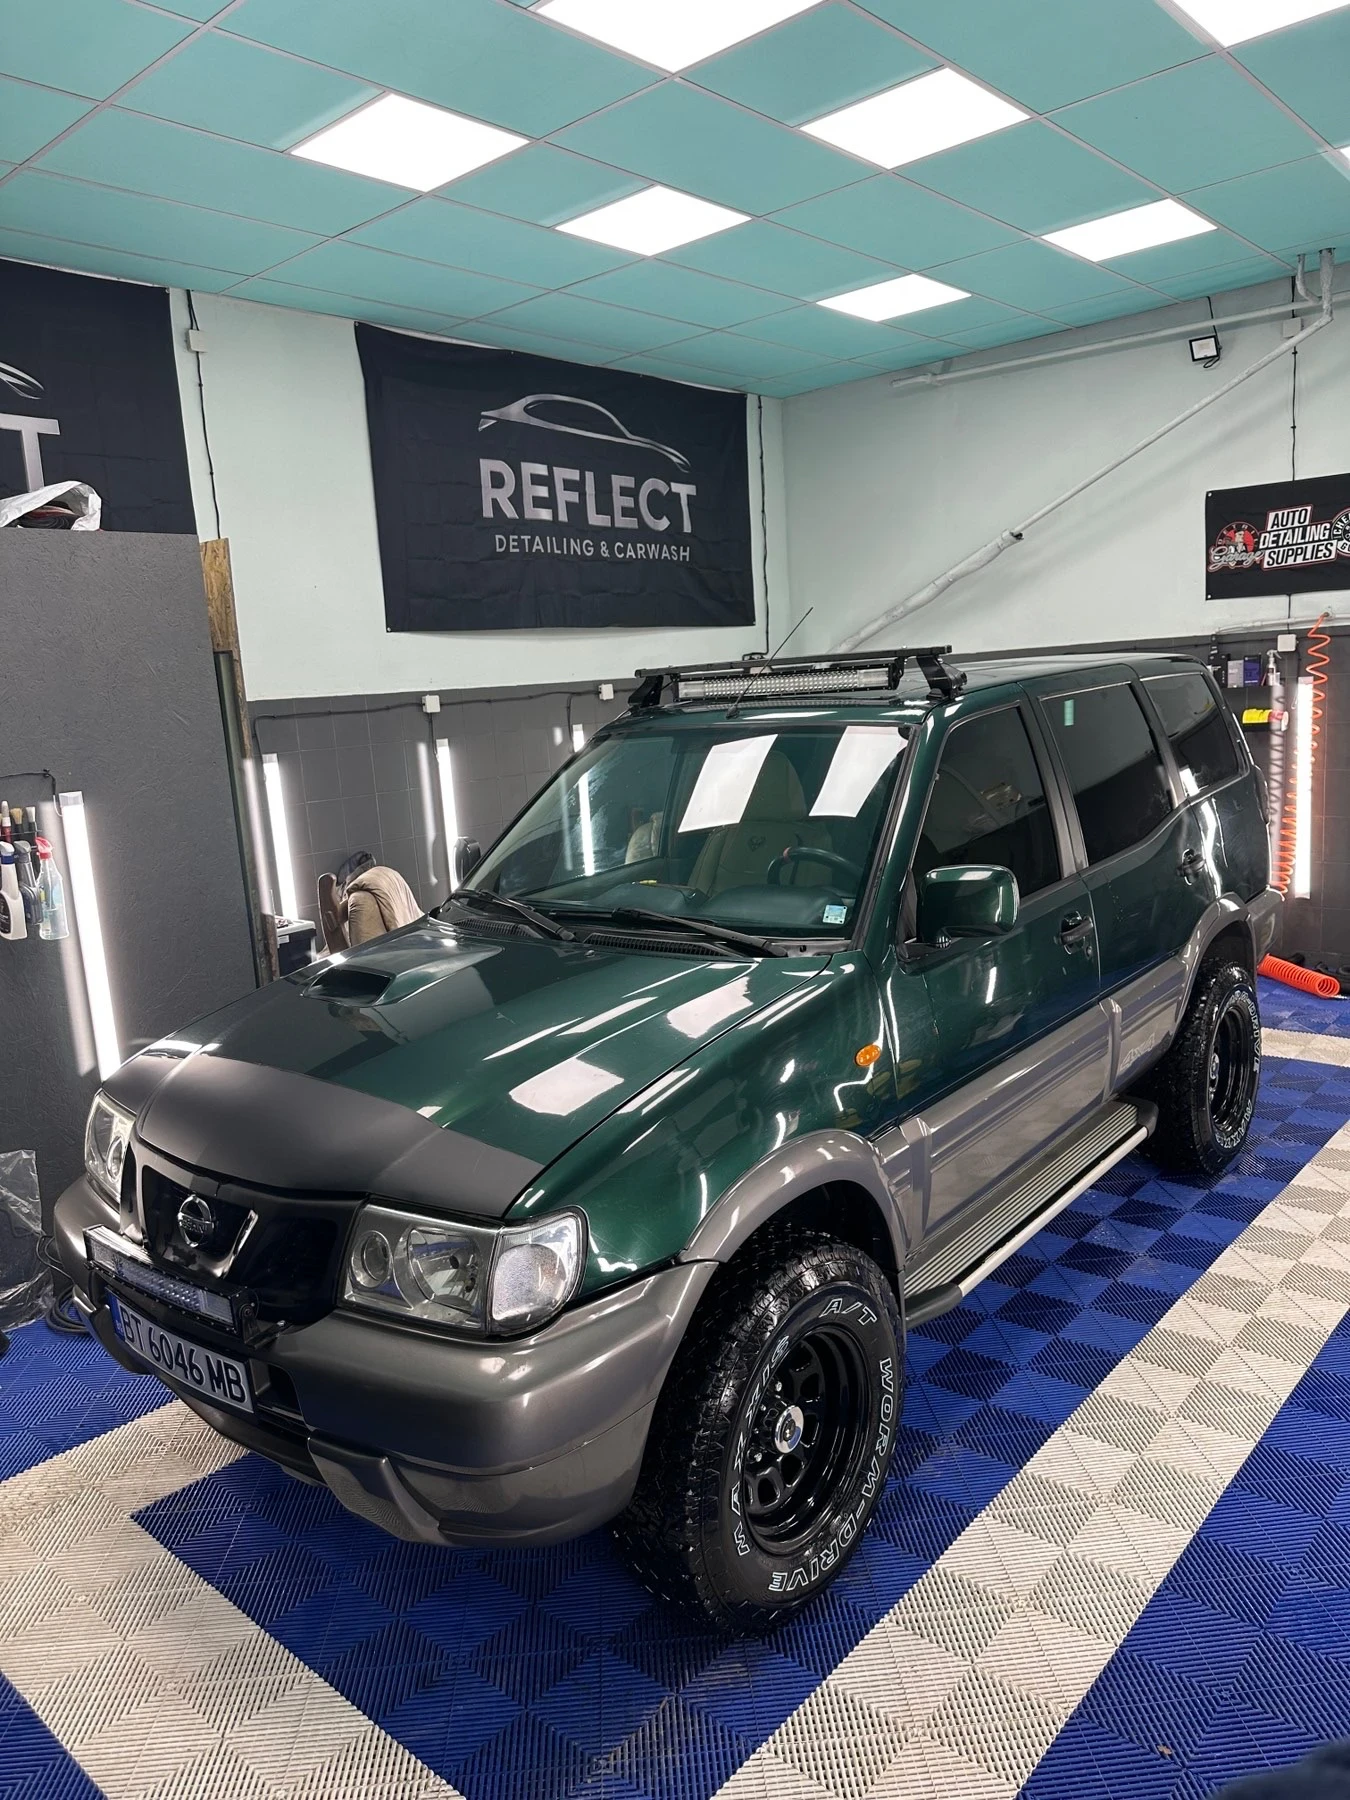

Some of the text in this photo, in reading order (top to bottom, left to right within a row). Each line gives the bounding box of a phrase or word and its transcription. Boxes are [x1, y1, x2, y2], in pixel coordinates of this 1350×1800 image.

[479, 458, 697, 533] REFLECT
[1271, 508, 1308, 529] AUTO
[495, 534, 690, 562] DETAILING & CARWASH
[1259, 523, 1330, 549] DETAILING
[1267, 542, 1333, 566] SUPPLIES
[819, 1298, 877, 1326] A/T
[120, 1304, 246, 1404] BT 6046 MB
[768, 1357, 894, 1593] WORM-DRIVE
